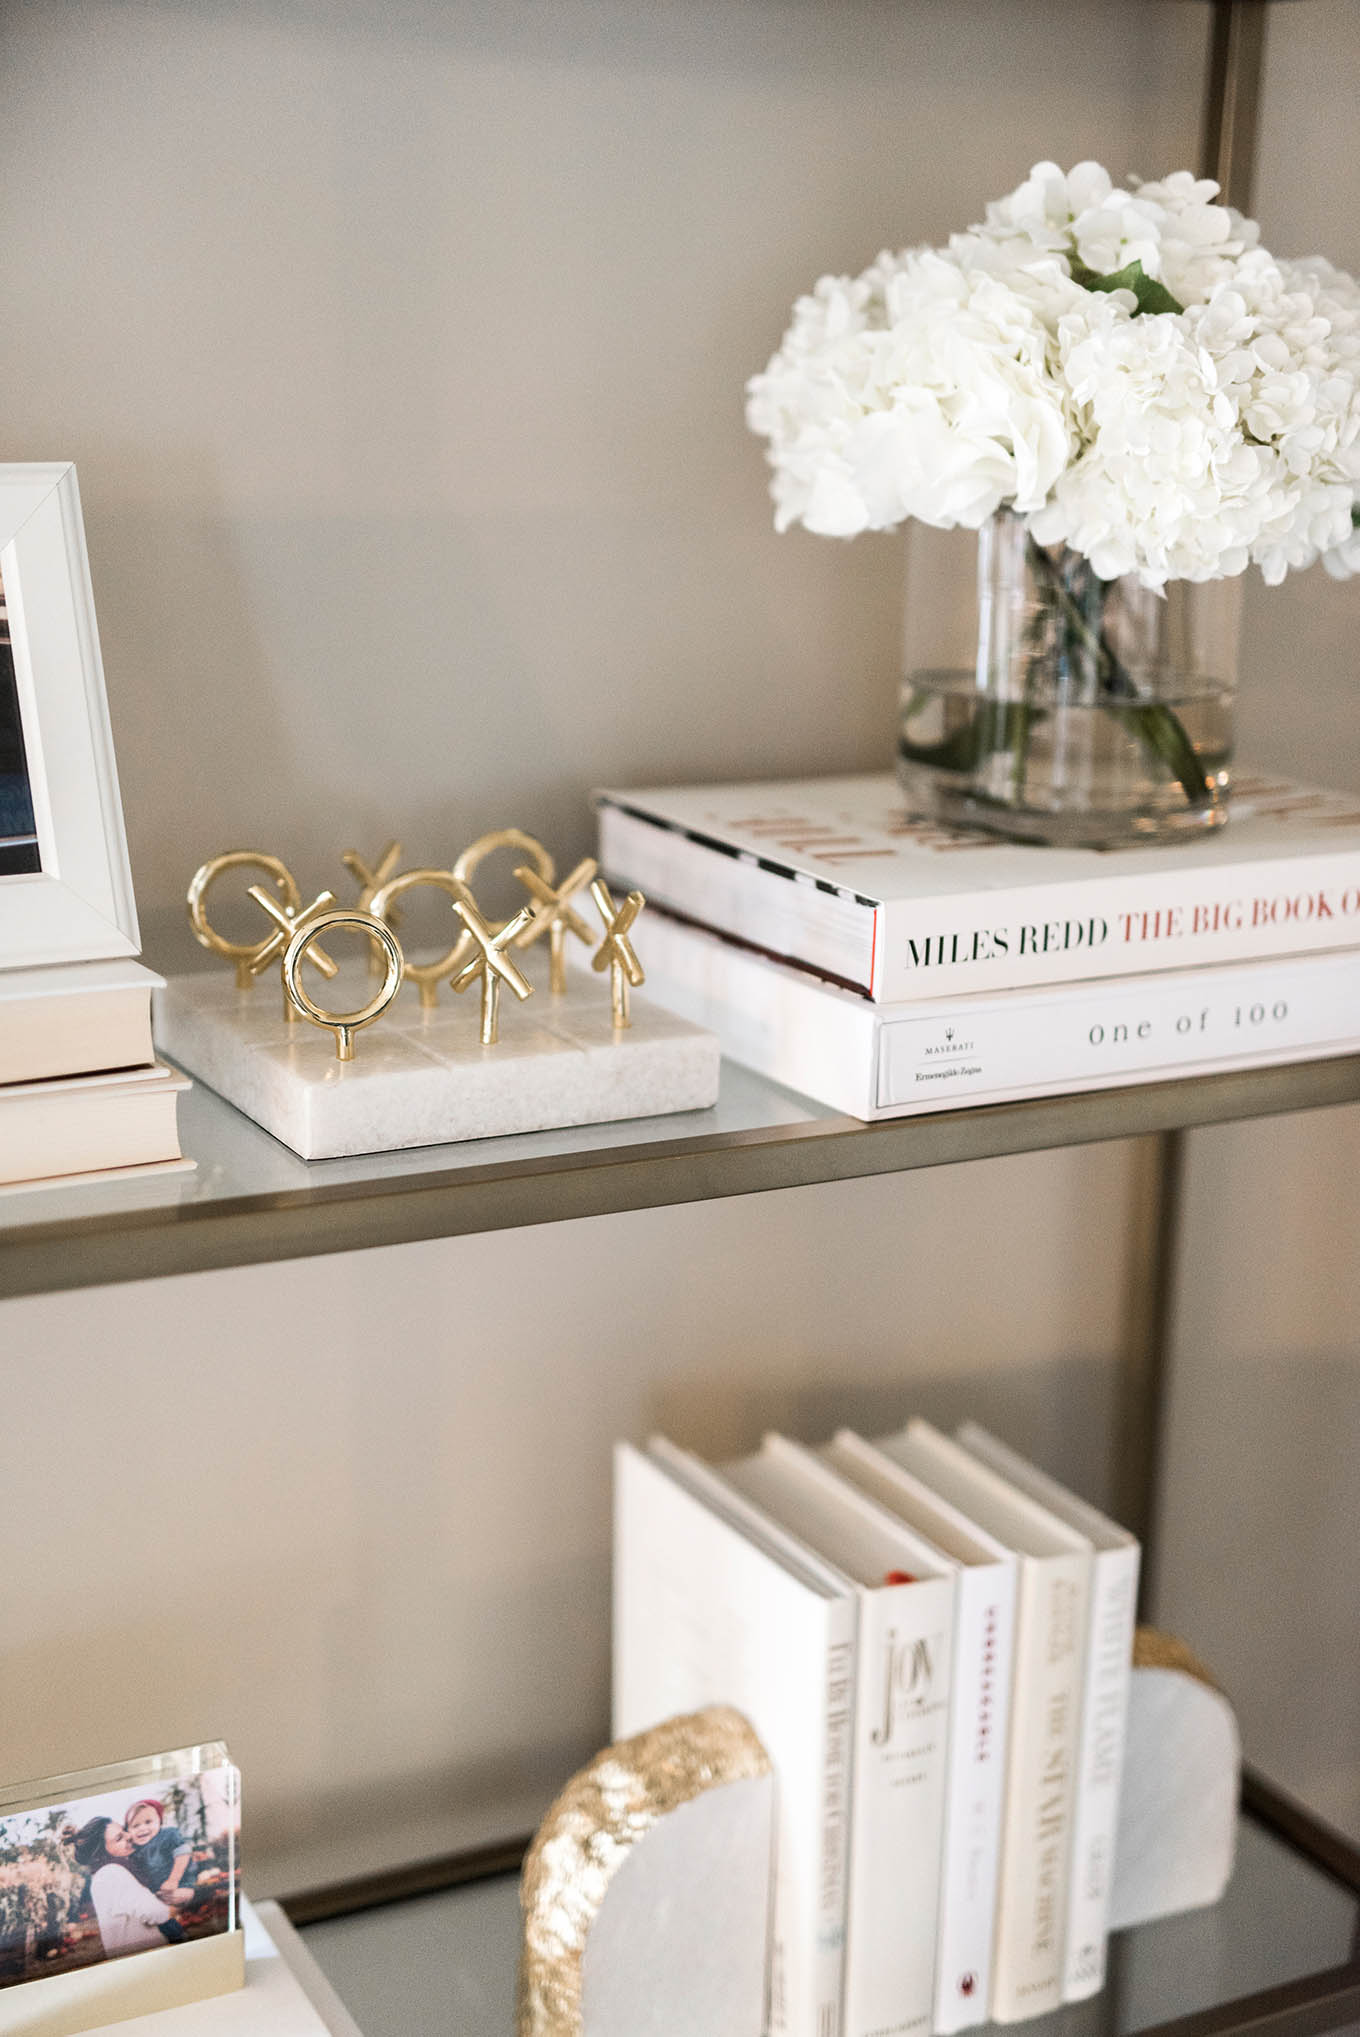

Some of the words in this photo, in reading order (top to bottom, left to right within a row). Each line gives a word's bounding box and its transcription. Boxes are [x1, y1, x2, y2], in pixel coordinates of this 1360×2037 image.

[905, 928, 1009, 969] MILES
[1019, 917, 1108, 955] REDD
[1118, 907, 1184, 943] THE
[1191, 899, 1243, 935] BIG
[1250, 889, 1335, 929] BOOK
[1089, 1020, 1152, 1046] one
[1176, 1006, 1209, 1034] of
[925, 1042, 974, 1055] MASERATI
